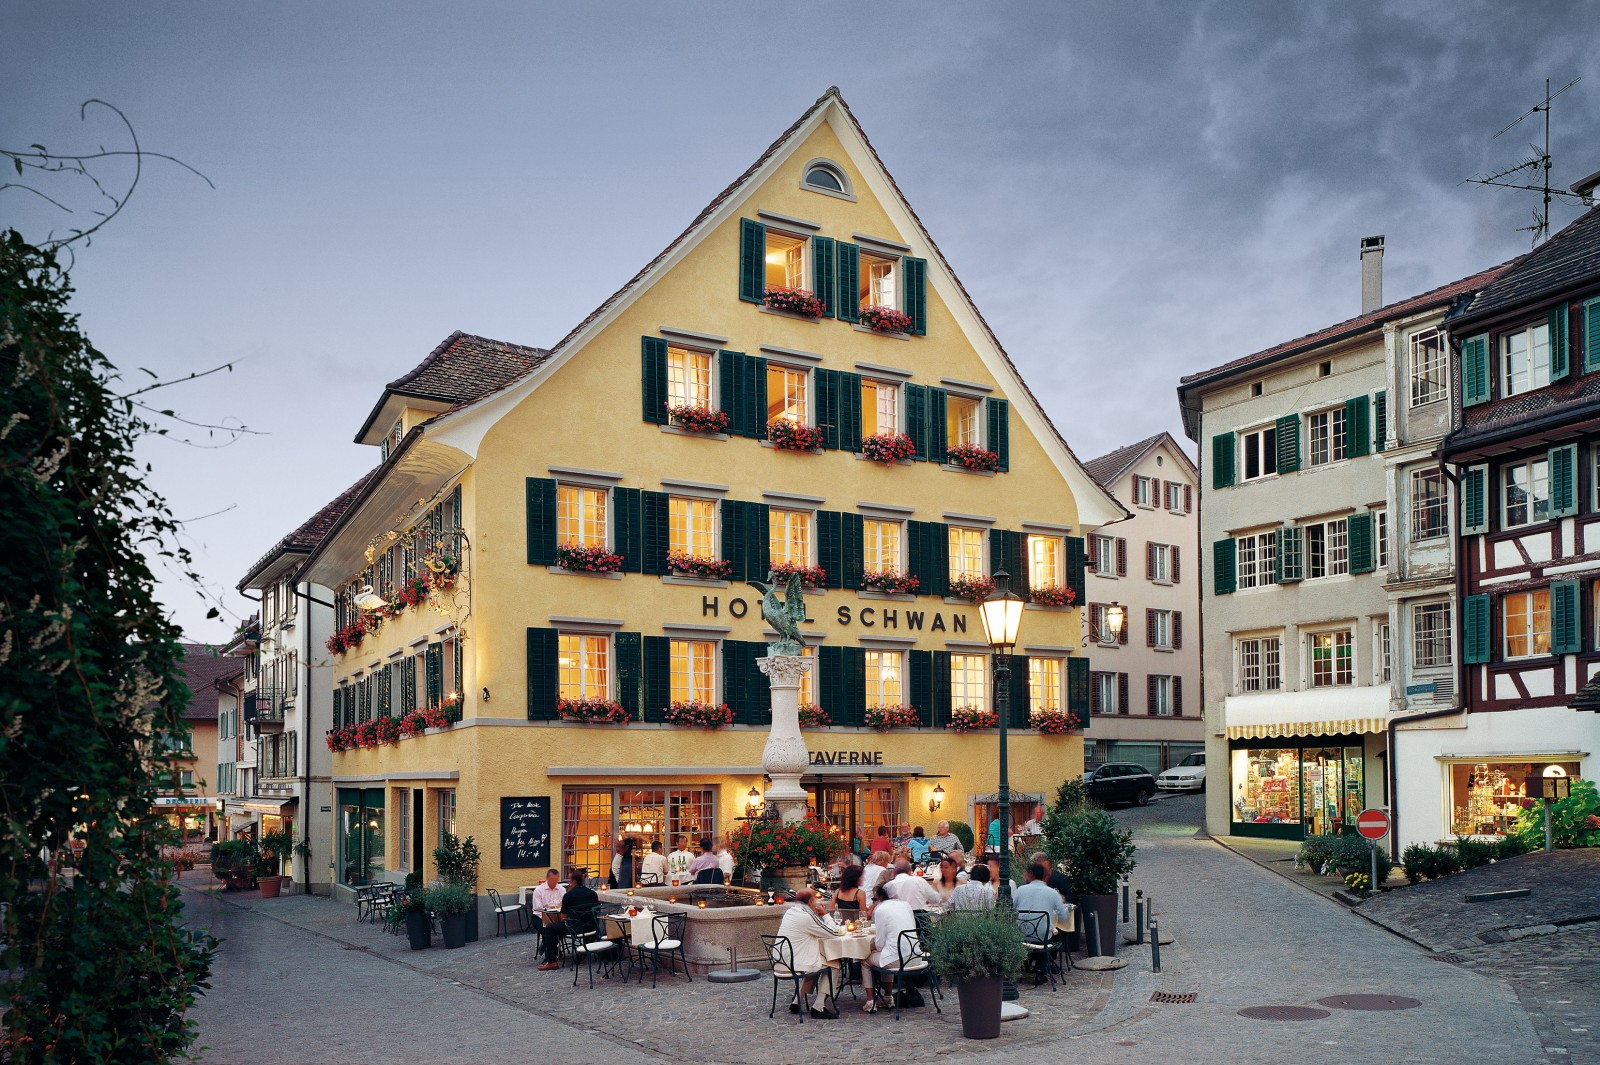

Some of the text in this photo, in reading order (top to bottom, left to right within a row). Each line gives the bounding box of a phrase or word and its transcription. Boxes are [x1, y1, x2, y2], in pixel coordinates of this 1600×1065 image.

[702, 595, 967, 633] HOTL SCHWAN
[808, 751, 883, 766] TAVERNE
